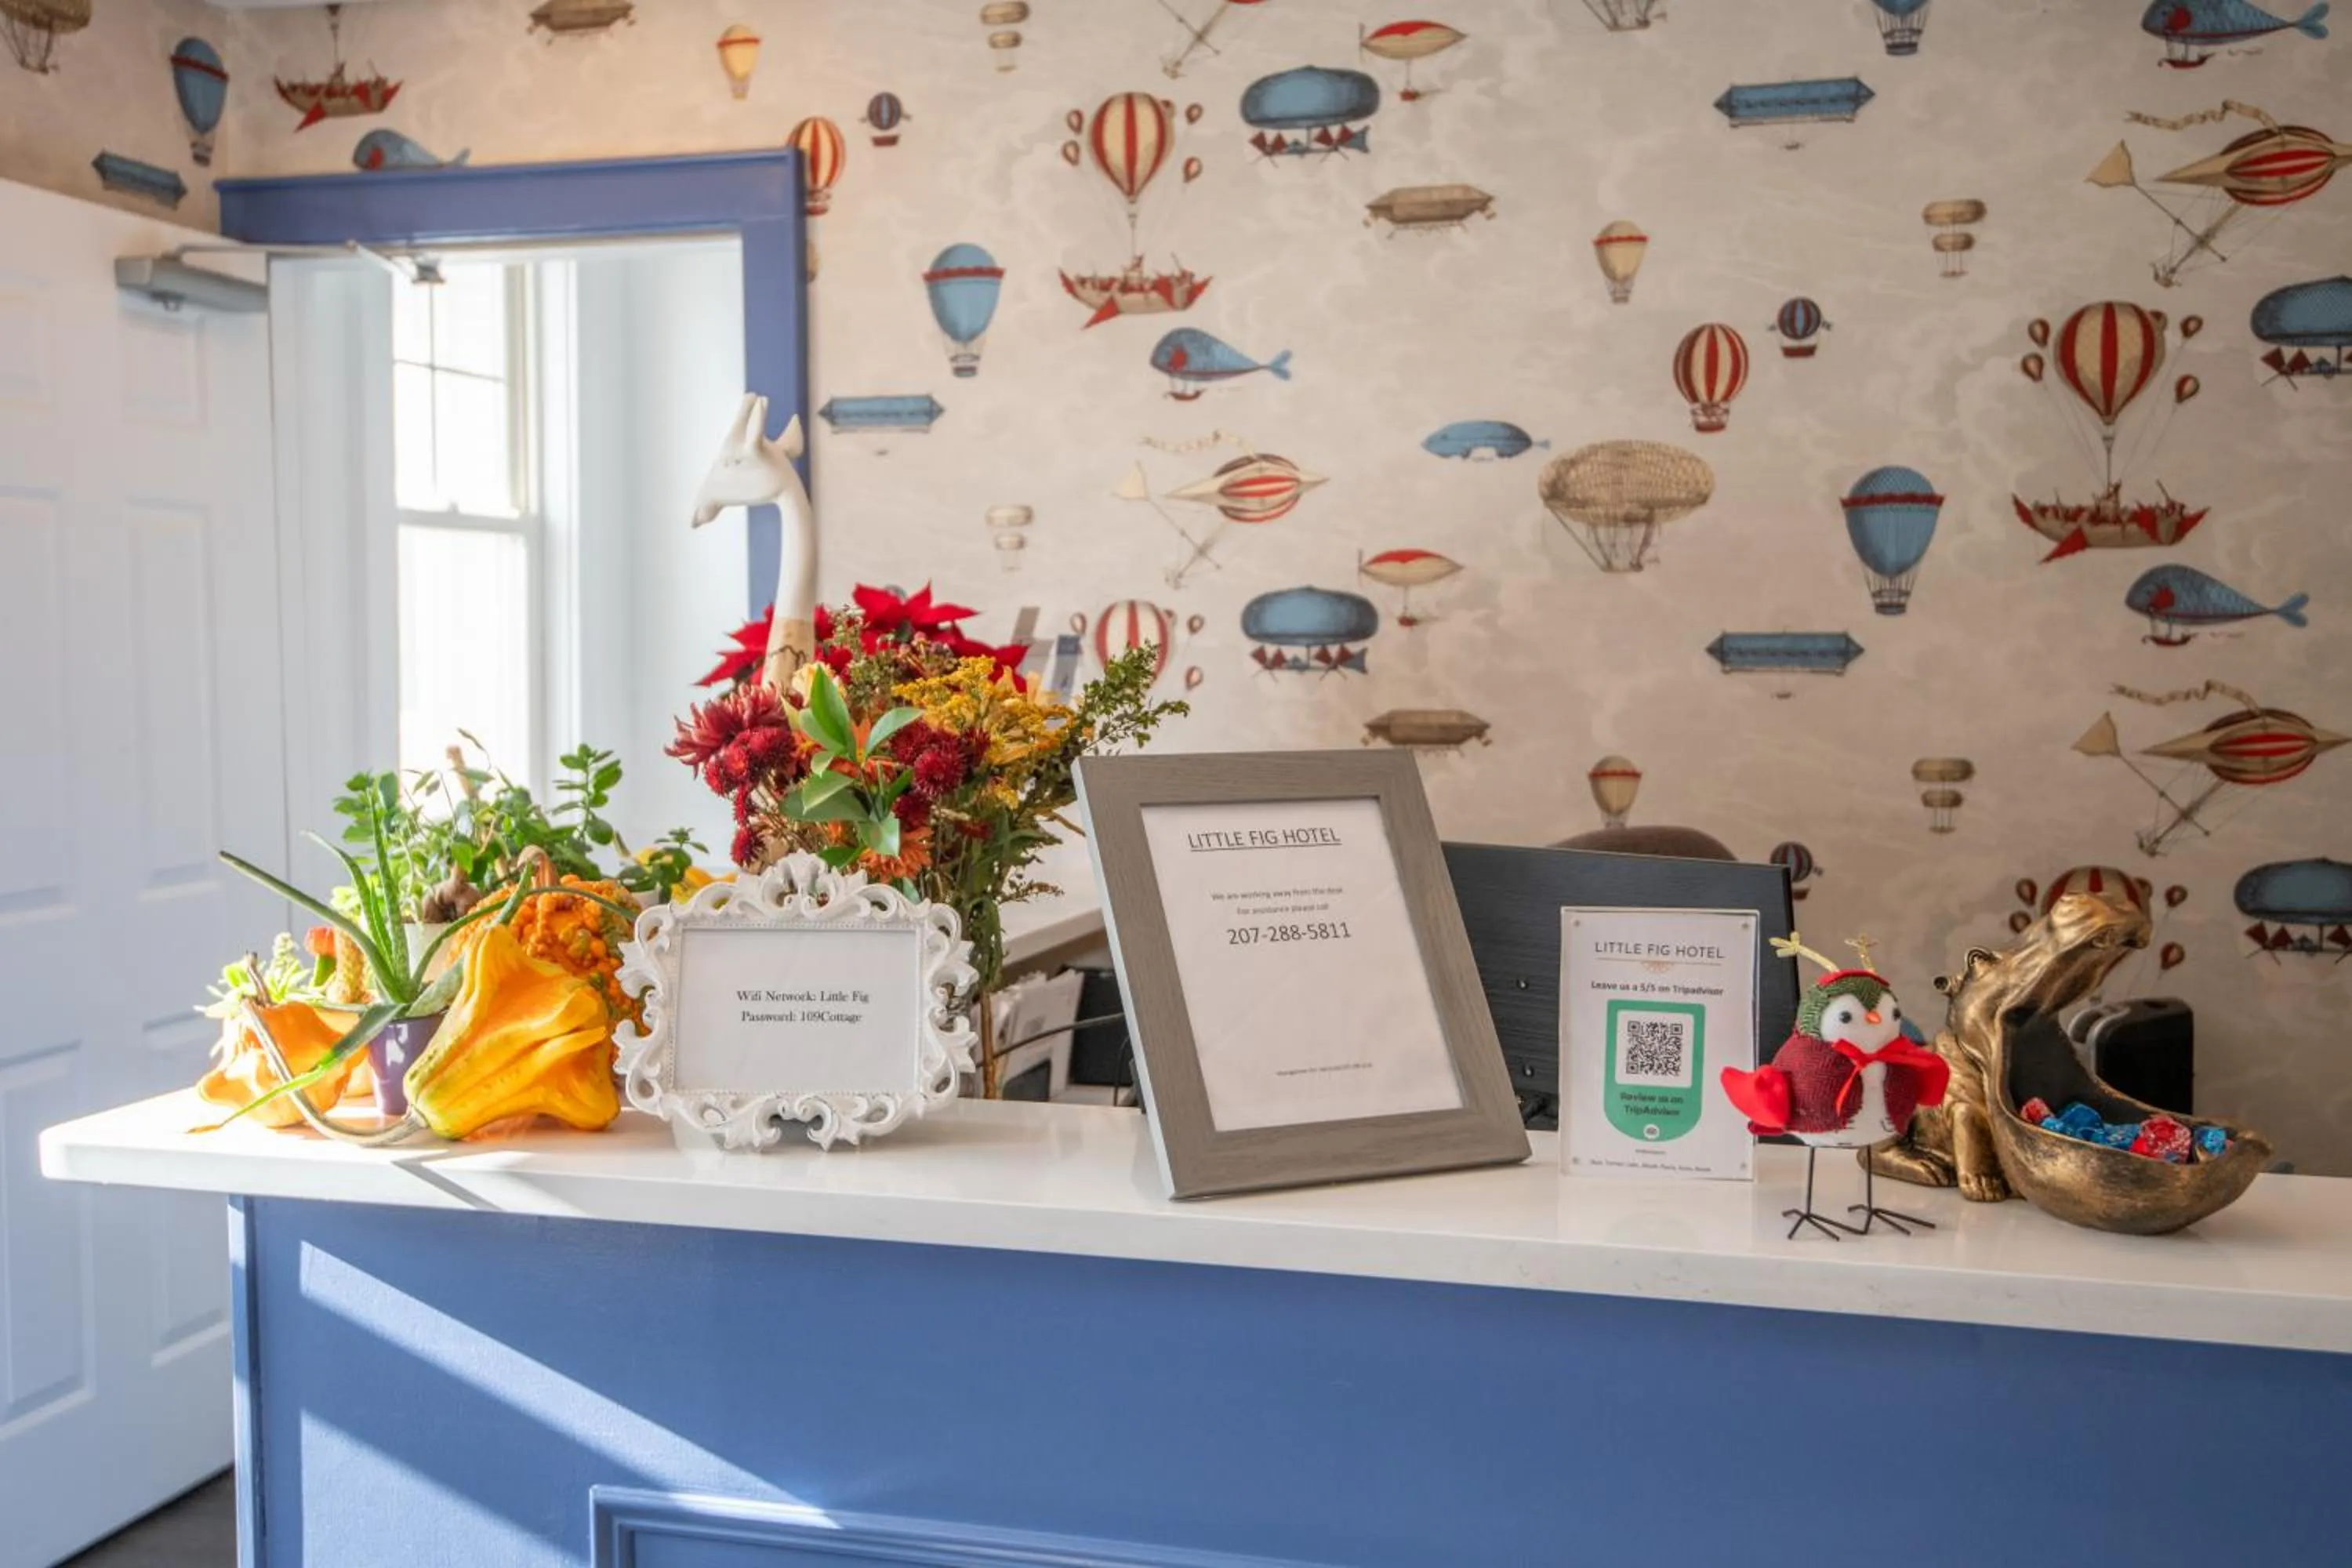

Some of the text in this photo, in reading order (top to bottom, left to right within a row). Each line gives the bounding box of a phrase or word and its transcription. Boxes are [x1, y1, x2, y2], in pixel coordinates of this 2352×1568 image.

[1188, 827, 1341, 849] LITTLE FIG HOTEL
[1226, 921, 1352, 946] 207-288-5811
[1595, 942, 1726, 959] LITTLE FIG HOTEL
[1591, 981, 1617, 990] Leave
[1639, 983, 1656, 993] 5/5
[1672, 985, 1724, 996] Tripadvisor
[736, 990, 869, 1004] Wifi Network: Little Fig
[741, 1010, 863, 1025] Password: 109Cottage
